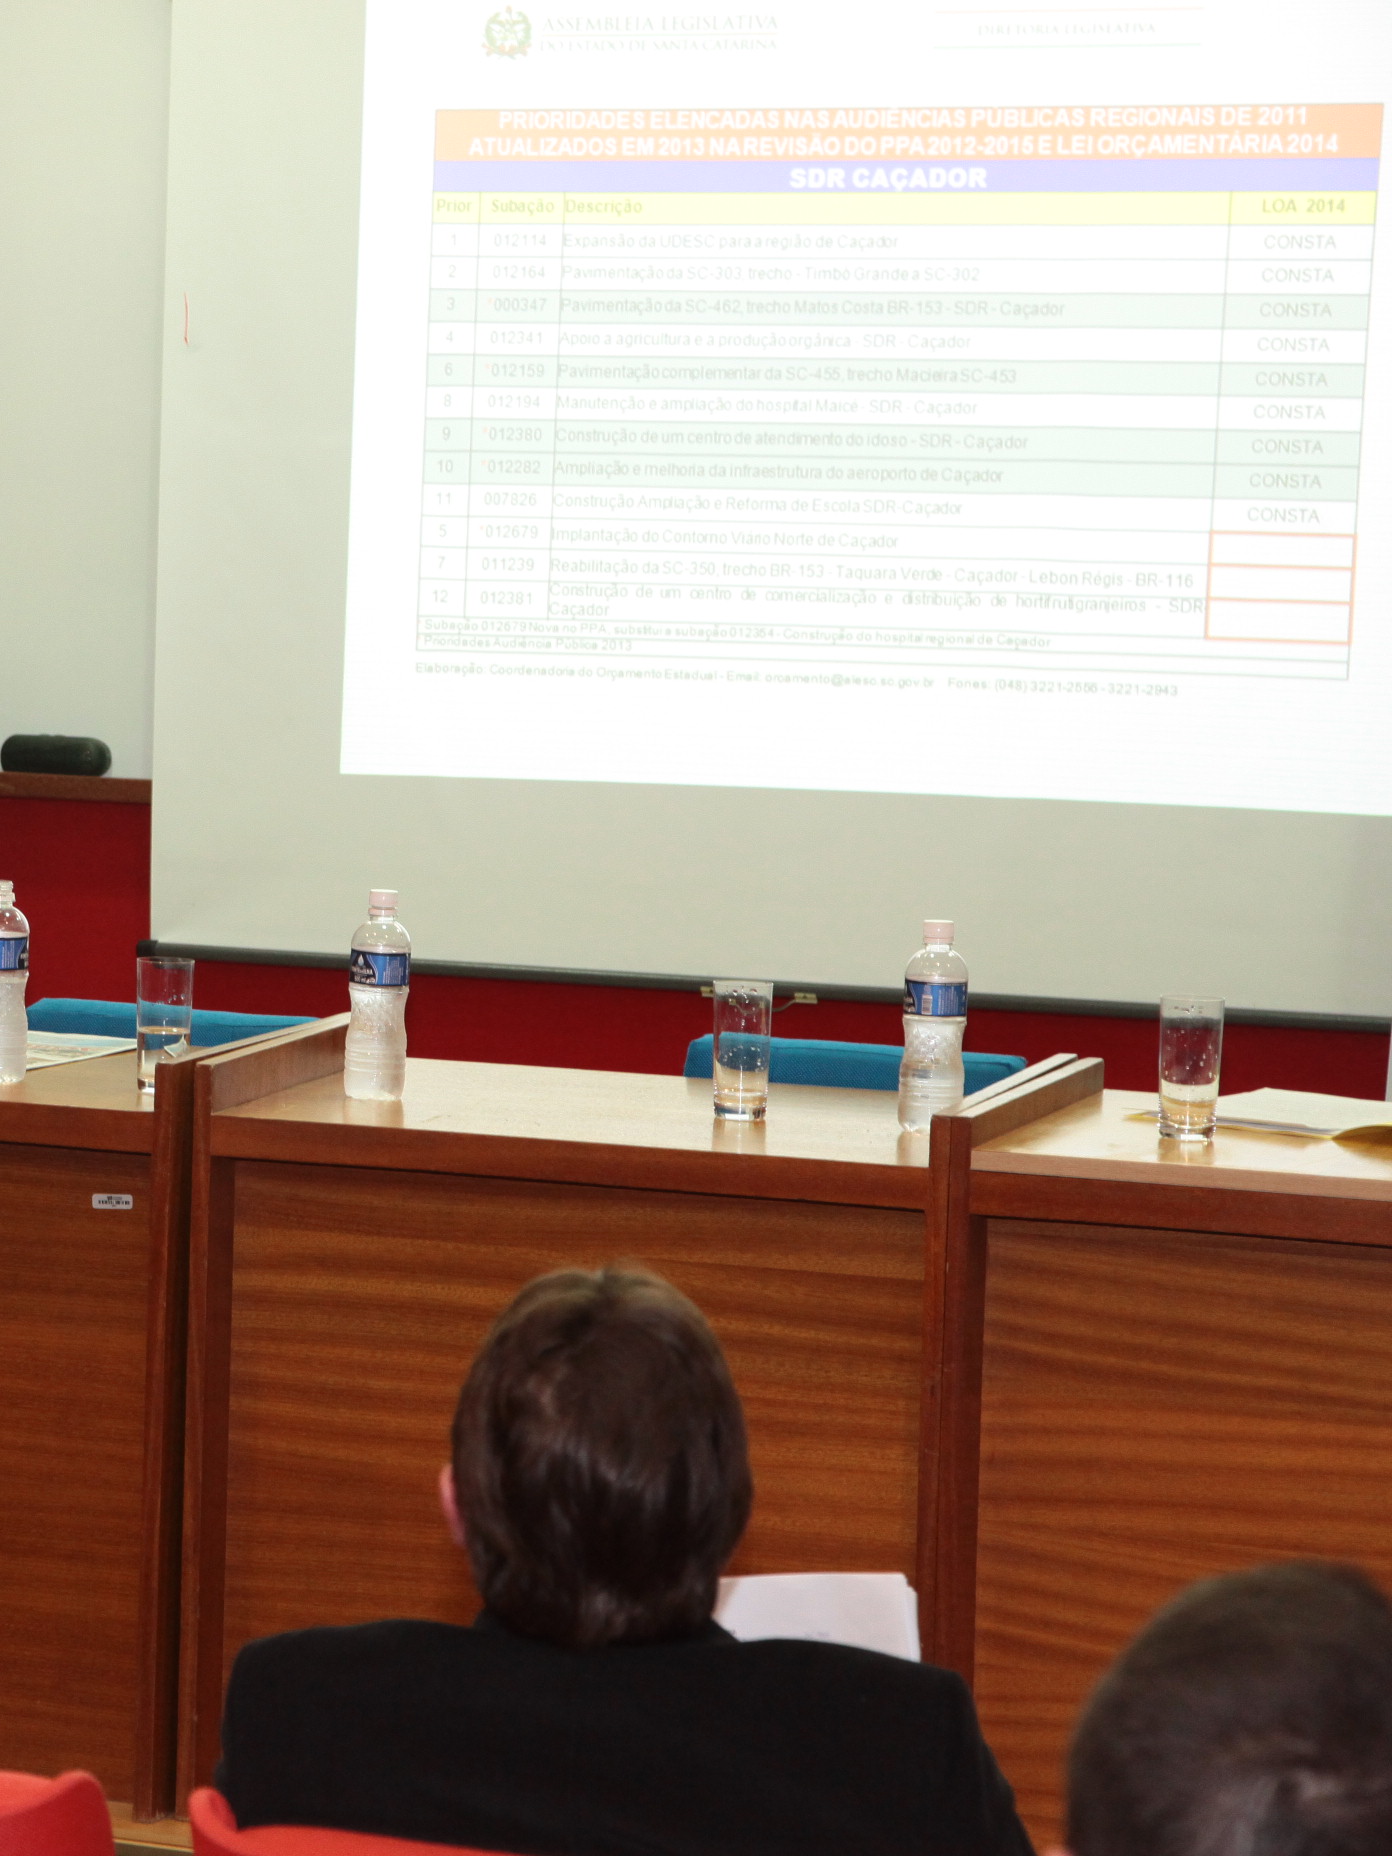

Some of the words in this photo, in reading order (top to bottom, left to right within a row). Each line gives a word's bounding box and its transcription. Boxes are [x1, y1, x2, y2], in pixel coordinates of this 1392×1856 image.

[543, 15, 655, 32] ASSEMBLEIA
[662, 14, 779, 31] LEGISLATIVA
[498, 110, 645, 129] PRIORIDADES
[650, 110, 779, 129] ELENCADAS
[784, 109, 829, 128] NAS
[1091, 107, 1215, 127] REGIONAIS
[1220, 106, 1252, 126] DE
[1258, 106, 1308, 125] 2011
[467, 137, 617, 156] ATUALIZADOS
[621, 137, 655, 156] EM
[658, 137, 705, 156] 2013
[709, 136, 741, 155] NA
[743, 132, 843, 155] REVISÃO
[844, 136, 878, 155] DO
[880, 136, 926, 155] PPA
[927, 135, 1035, 155] 2012-2015
[1038, 135, 1053, 154] E
[1057, 135, 1094, 154] LEI
[1097, 130, 1284, 158] ORÇAMENTÁRIA
[1286, 133, 1340, 153] 2014
[789, 168, 846, 189] SDR
[852, 167, 988, 193] CAÇADOR
[436, 199, 473, 213] Prior
[491, 199, 555, 217] Subação
[565, 199, 644, 217] Descrição
[1261, 199, 1298, 214] LOA
[1305, 199, 1347, 214] 2014
[494, 234, 547, 247] 012114
[564, 234, 636, 251] Expansão
[639, 234, 656, 248] da
[660, 234, 715, 248] UDESC
[719, 237, 753, 251] para
[765, 234, 812, 251] região
[815, 234, 834, 248] de
[837, 234, 898, 252] Caçador
[1263, 235, 1337, 250] CONSTA
[493, 265, 546, 279] 012164
[666, 266, 684, 280] da
[748, 267, 793, 281] trecho
[854, 267, 908, 281] Grande
[924, 267, 981, 282] SC-302
[1261, 268, 1335, 283] CONSTA
[664, 299, 682, 313] da
[746, 300, 791, 314] trecho
[794, 300, 838, 315] Matos
[841, 301, 884, 315] Costa
[954, 301, 988, 316] SDR
[1000, 302, 1065, 319] Caçador
[1259, 302, 1333, 318] CONSTA
[445, 331, 454, 344] 4
[490, 331, 543, 345] 012341
[560, 331, 601, 348] Apoio
[616, 332, 691, 349] agricultura
[718, 333, 788, 350] produção
[863, 334, 897, 348] SDR
[908, 335, 972, 352] Caçador
[1257, 337, 1330, 352] CONSTA
[444, 363, 453, 376] 6
[661, 366, 760, 384] complementar
[764, 367, 782, 381] da
[847, 368, 893, 382] trecho
[896, 368, 957, 383] Macieira
[960, 369, 1017, 384] SC-453
[1255, 371, 1328, 387] CONSTA
[443, 394, 452, 408] 8
[487, 395, 541, 409] 012194
[557, 396, 645, 414] Manutenção
[661, 397, 733, 414] ampliação
[736, 398, 754, 412] do
[757, 398, 812, 415] hospital
[869, 399, 903, 413] SDR
[914, 400, 978, 417] Caçador
[1253, 404, 1326, 420] CONSTA
[442, 427, 451, 441] 9
[557, 428, 637, 446] Construção
[641, 430, 658, 443] de
[661, 433, 684, 444] um
[688, 430, 732, 445] centro
[734, 431, 752, 445] de
[755, 431, 843, 446] atendimento
[846, 433, 864, 447] do
[867, 433, 908, 447] idoso
[919, 434, 952, 448] SDR
[963, 435, 1028, 452] Caçador
[1251, 438, 1324, 454] CONSTA
[437, 459, 454, 474] 10
[555, 461, 629, 479] Ampliação
[645, 462, 705, 477] melhoria
[709, 463, 726, 477] da
[730, 463, 823, 479] infraestrutura
[826, 465, 844, 479] do
[847, 465, 917, 484] aeroporto
[921, 466, 938, 481] de
[941, 467, 1003, 485] Caçador
[1249, 473, 1322, 489] CONSTA
[437, 492, 452, 506] 11
[484, 493, 537, 507] 007826
[553, 494, 634, 512] Construção
[637, 495, 710, 513] Ampliação
[726, 497, 787, 512] Reforma
[791, 498, 809, 512] de
[812, 498, 860, 513] Escola
[1247, 507, 1320, 523] CONSTA
[439, 525, 448, 539] 5
[551, 528, 638, 547] Implantação
[642, 530, 660, 544] do
[663, 530, 727, 545] Contorno
[774, 532, 814, 547] Norte
[817, 533, 835, 547] de
[838, 533, 899, 551] Caçador
[437, 556, 446, 569] 7
[481, 557, 535, 571] 011239
[552, 560, 638, 579] Reabilitação
[642, 562, 659, 576] da
[722, 563, 767, 578] trecho
[836, 566, 897, 584] Taquara
[900, 567, 943, 582] Verde
[954, 568, 1018, 587] Caçador
[1029, 570, 1079, 585] Lebon
[1082, 571, 1123, 589] Régis
[432, 590, 449, 603] 12
[480, 590, 533, 605] 012381
[550, 583, 629, 602] Construção
[635, 585, 654, 599] de
[660, 589, 682, 600] um
[690, 587, 732, 601] centro
[741, 588, 757, 602] de
[765, 589, 877, 608] comercialização
[990, 595, 1007, 608] de
[550, 602, 610, 620] Caçador
